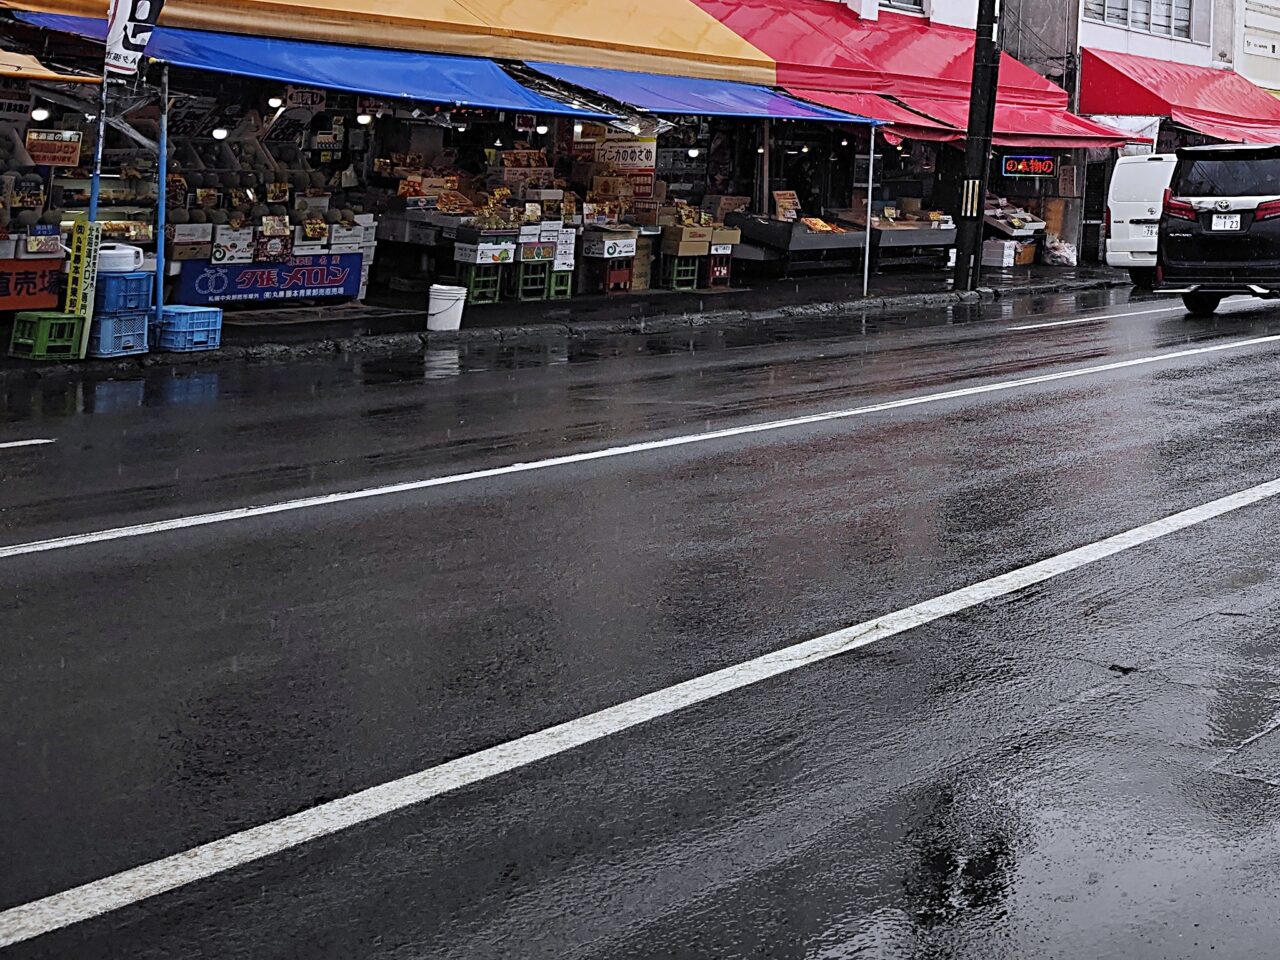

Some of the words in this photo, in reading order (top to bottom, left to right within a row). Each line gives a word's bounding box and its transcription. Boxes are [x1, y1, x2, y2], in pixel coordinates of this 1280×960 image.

[600, 147, 654, 162] インカのめざめ
[235, 265, 351, 290] 夕張メロン
